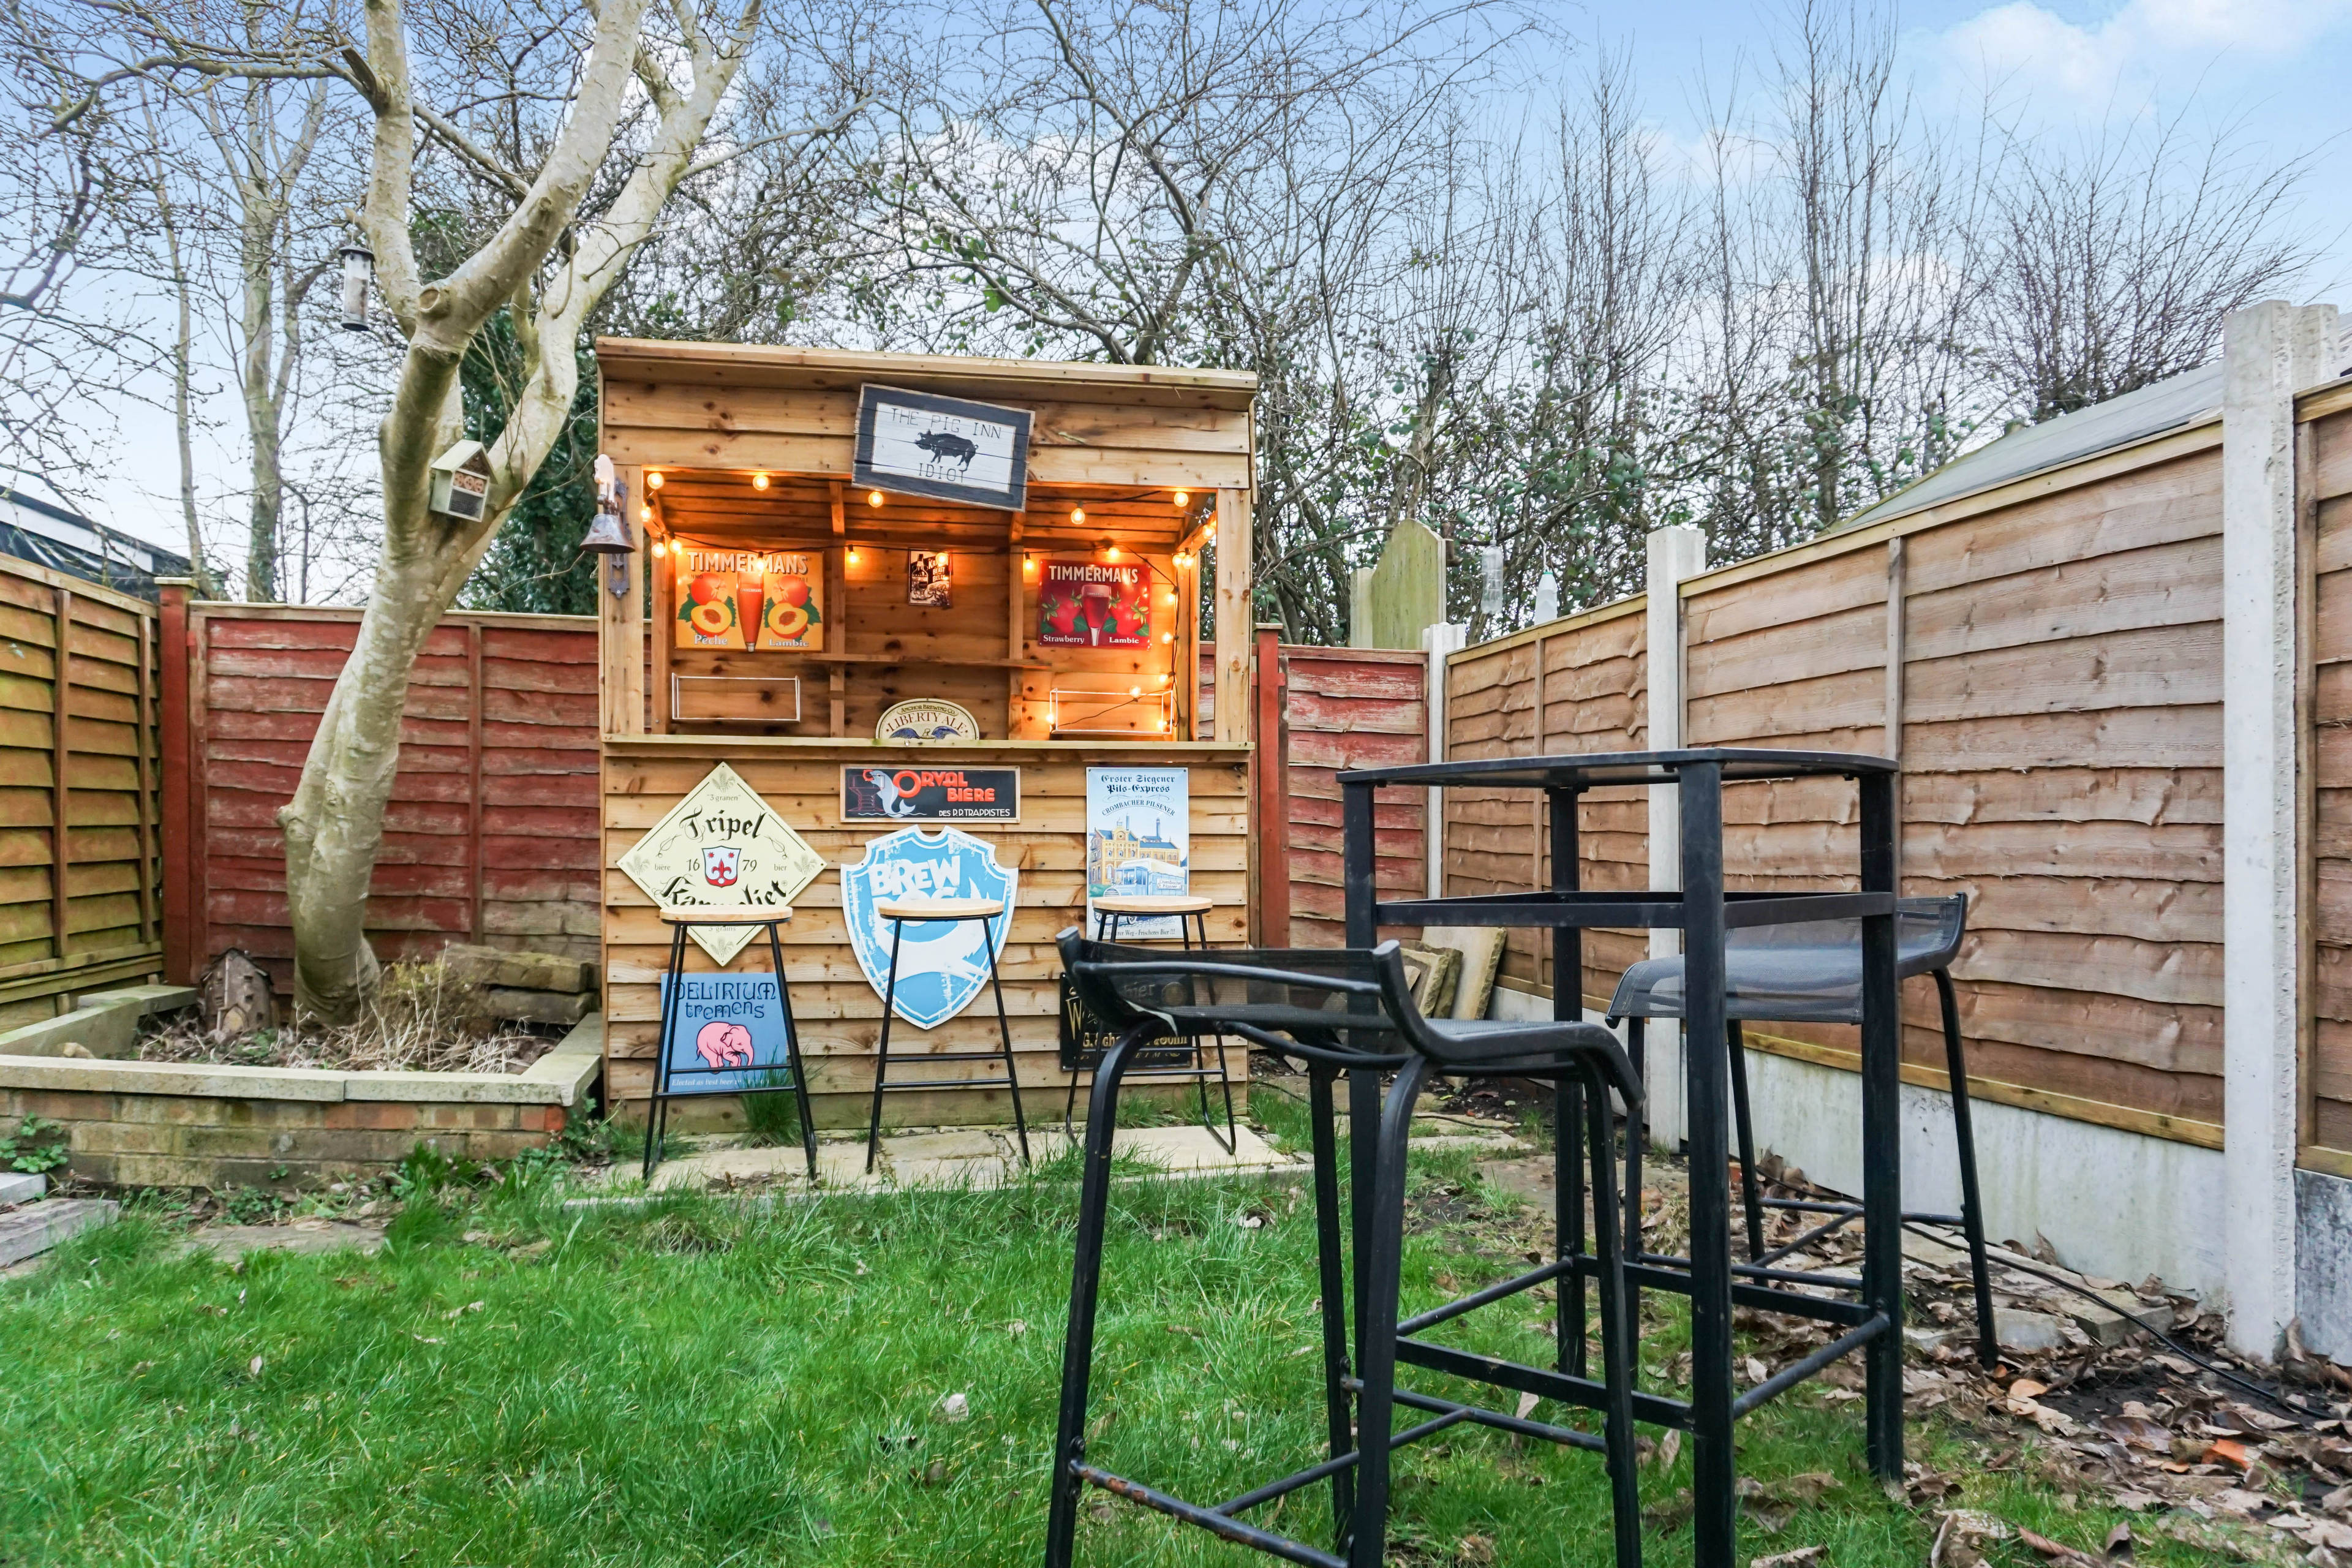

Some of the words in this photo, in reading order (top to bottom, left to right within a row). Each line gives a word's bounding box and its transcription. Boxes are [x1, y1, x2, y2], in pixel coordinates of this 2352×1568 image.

[891, 407, 919, 426] THE
[930, 415, 960, 432] PIG
[973, 422, 1001, 439] INN
[918, 462, 966, 483] IDIOT
[687, 552, 809, 575] TIMMERMANS
[1049, 565, 1139, 584] TIMMERMANS
[695, 634, 728, 645] Pêche
[1043, 635, 1085, 644] Strawberry
[923, 704, 947, 712] BREWING
[888, 712, 941, 731] LIBERTY
[941, 715, 967, 733] ALE
[893, 769, 968, 798] ORVAL
[947, 788, 995, 802] BIERE
[1102, 799, 1144, 816] CROMBACHER
[1146, 800, 1175, 816] PILSENER
[679, 804, 767, 843] Tripel
[687, 859, 700, 873] 16
[742, 859, 758, 872] 79
[773, 863, 787, 872] bier
[868, 855, 961, 897] BREW
[673, 982, 776, 1000] DELIRIUM
[685, 1001, 764, 1019] tremens
